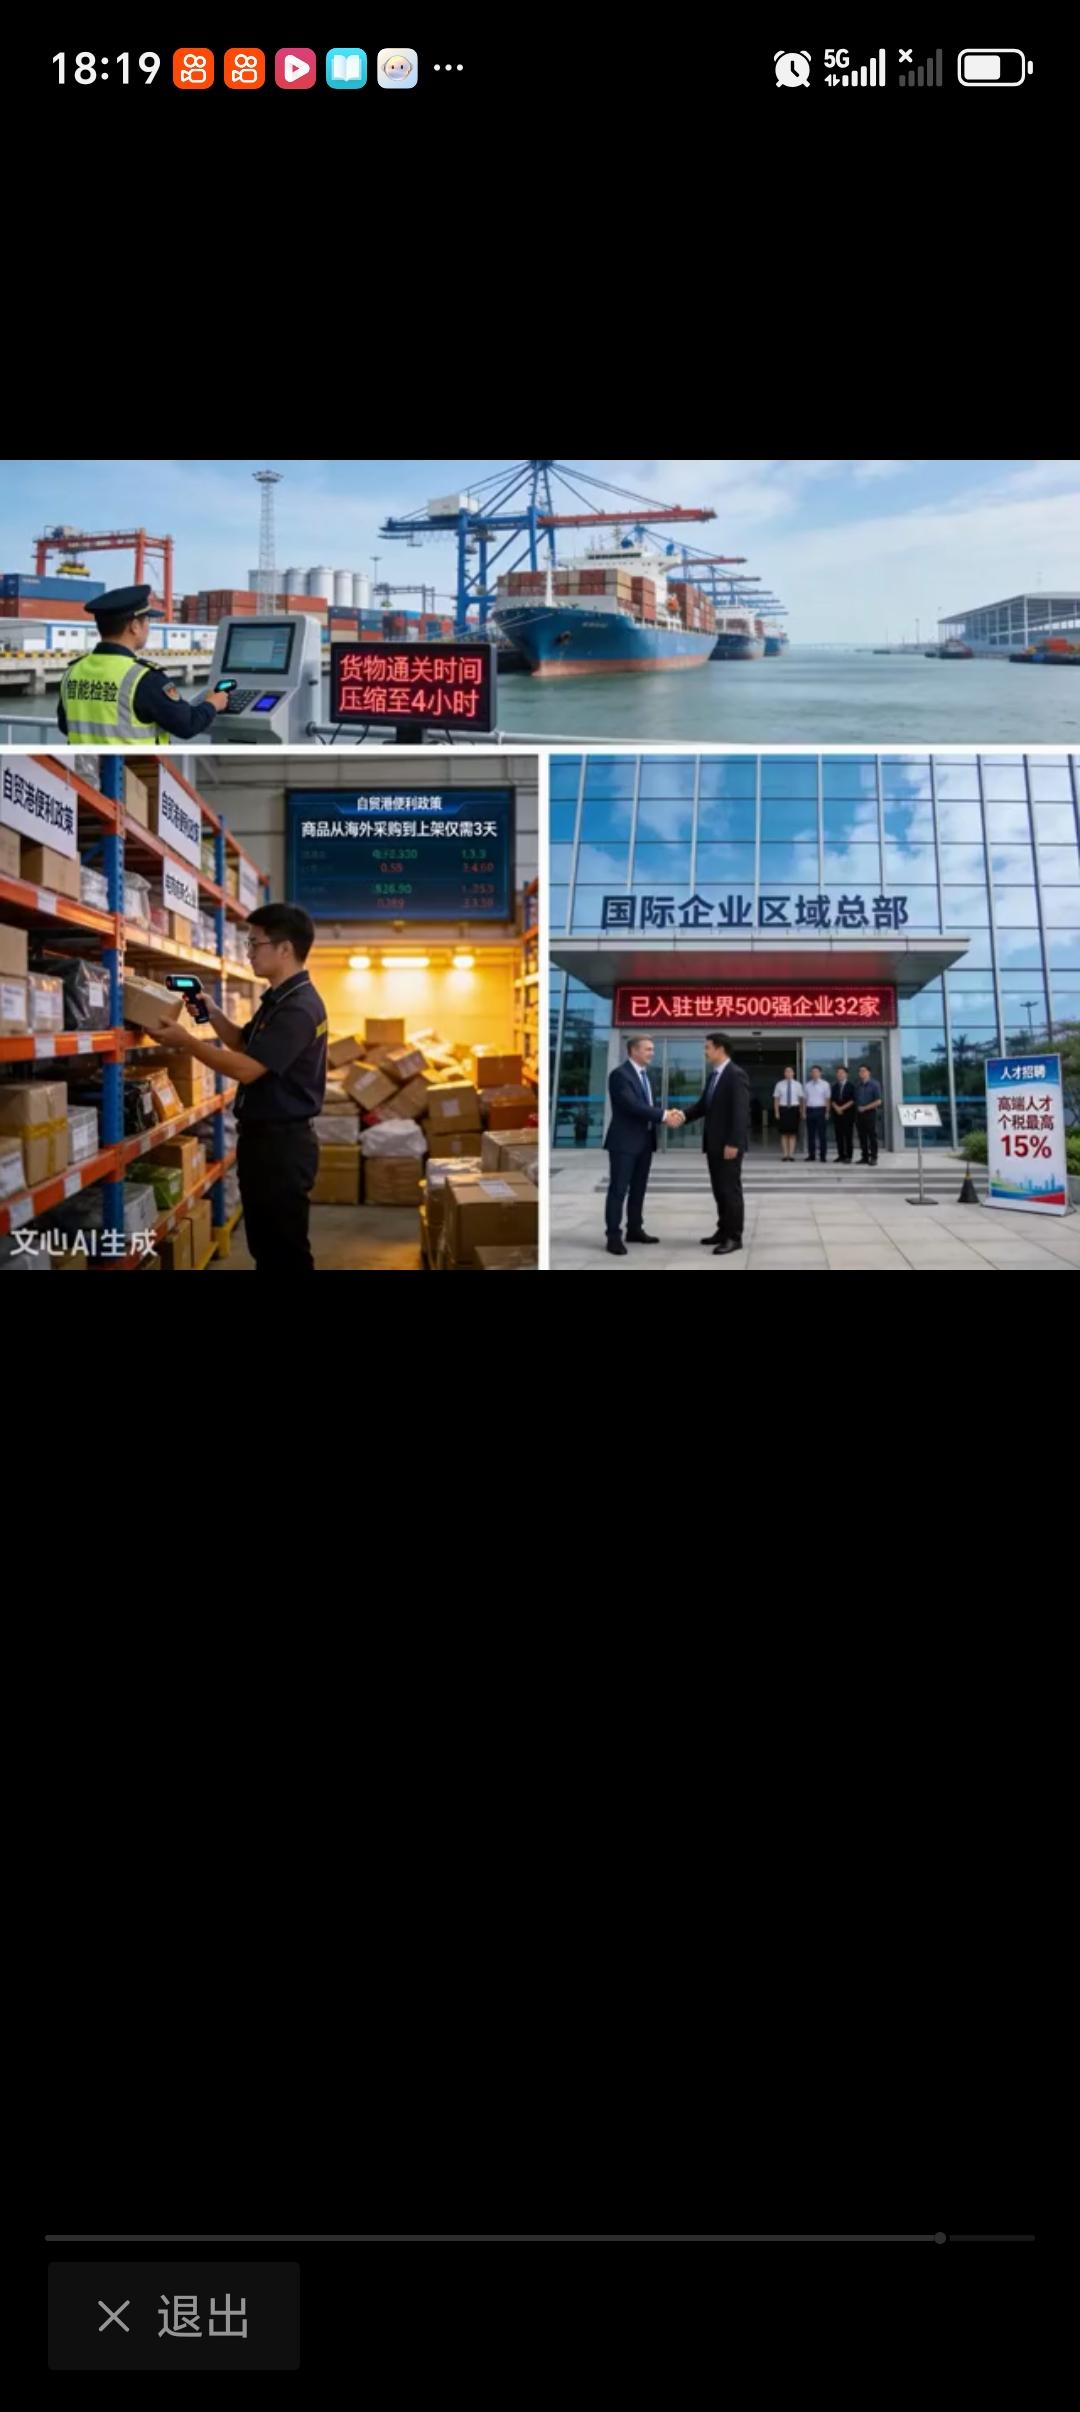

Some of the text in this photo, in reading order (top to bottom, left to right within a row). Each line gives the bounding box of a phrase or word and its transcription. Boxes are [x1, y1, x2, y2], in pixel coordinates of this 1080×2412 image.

[339, 655, 482, 685] 货物通关时间
[67, 679, 118, 702] 智能检验
[339, 688, 479, 717] 压缩至4小时
[3, 767, 74, 836] 自贸港便利政策
[357, 796, 442, 811] 自贸港便利政策
[301, 820, 498, 838] 商品从海外采购到上架仅需3天
[600, 895, 909, 930] 国际企业区域总部
[630, 995, 880, 1018] 已入驻世界500强企业32家
[1000, 1064, 1046, 1080] 人才招聘
[997, 1095, 1052, 1112] 高端人才
[998, 1114, 1055, 1131] 个税最高
[1001, 1134, 1053, 1159] 15%
